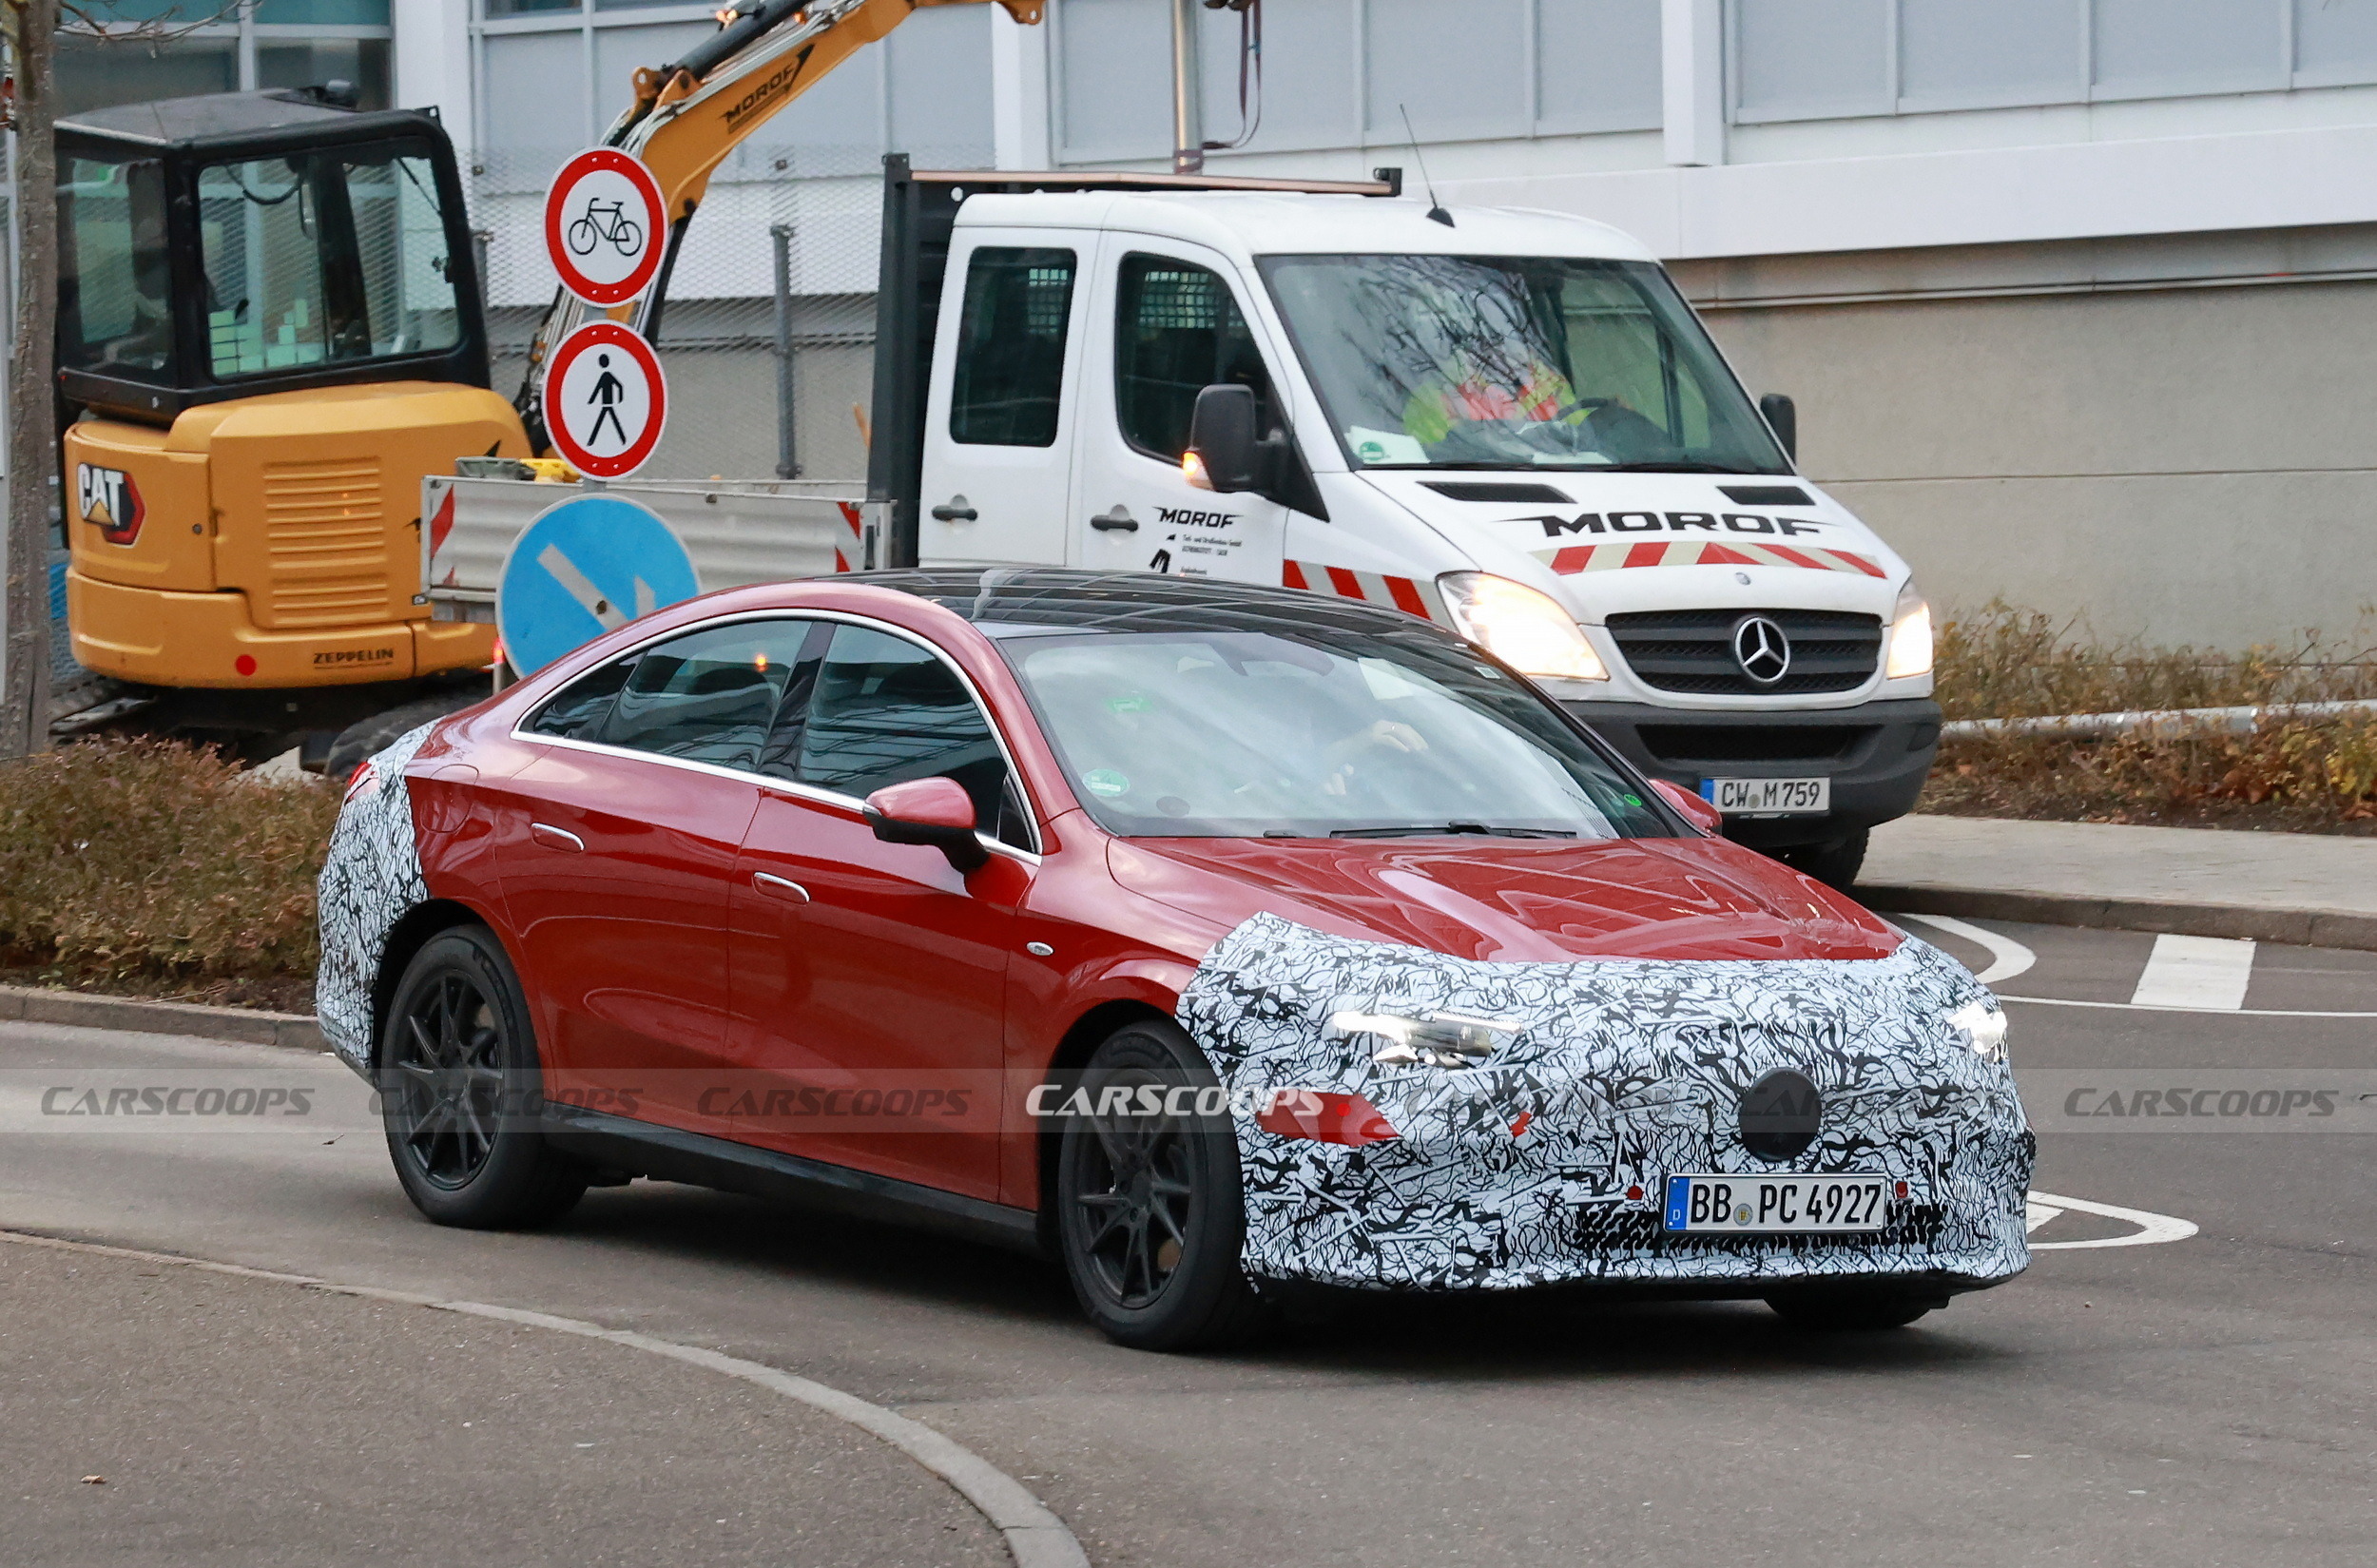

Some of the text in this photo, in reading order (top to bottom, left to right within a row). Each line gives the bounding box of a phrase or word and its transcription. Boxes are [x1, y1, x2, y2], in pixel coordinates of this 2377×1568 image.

[717, 63, 794, 124] MOROF
[77, 463, 125, 527] CAT
[1152, 506, 1244, 529] MOROF
[1498, 511, 1838, 538] MOROF
[313, 648, 394, 665] ZEPPELIN
[1722, 781, 1821, 807] CW M 759
[1691, 1184, 1882, 1223] BB PC 4927
